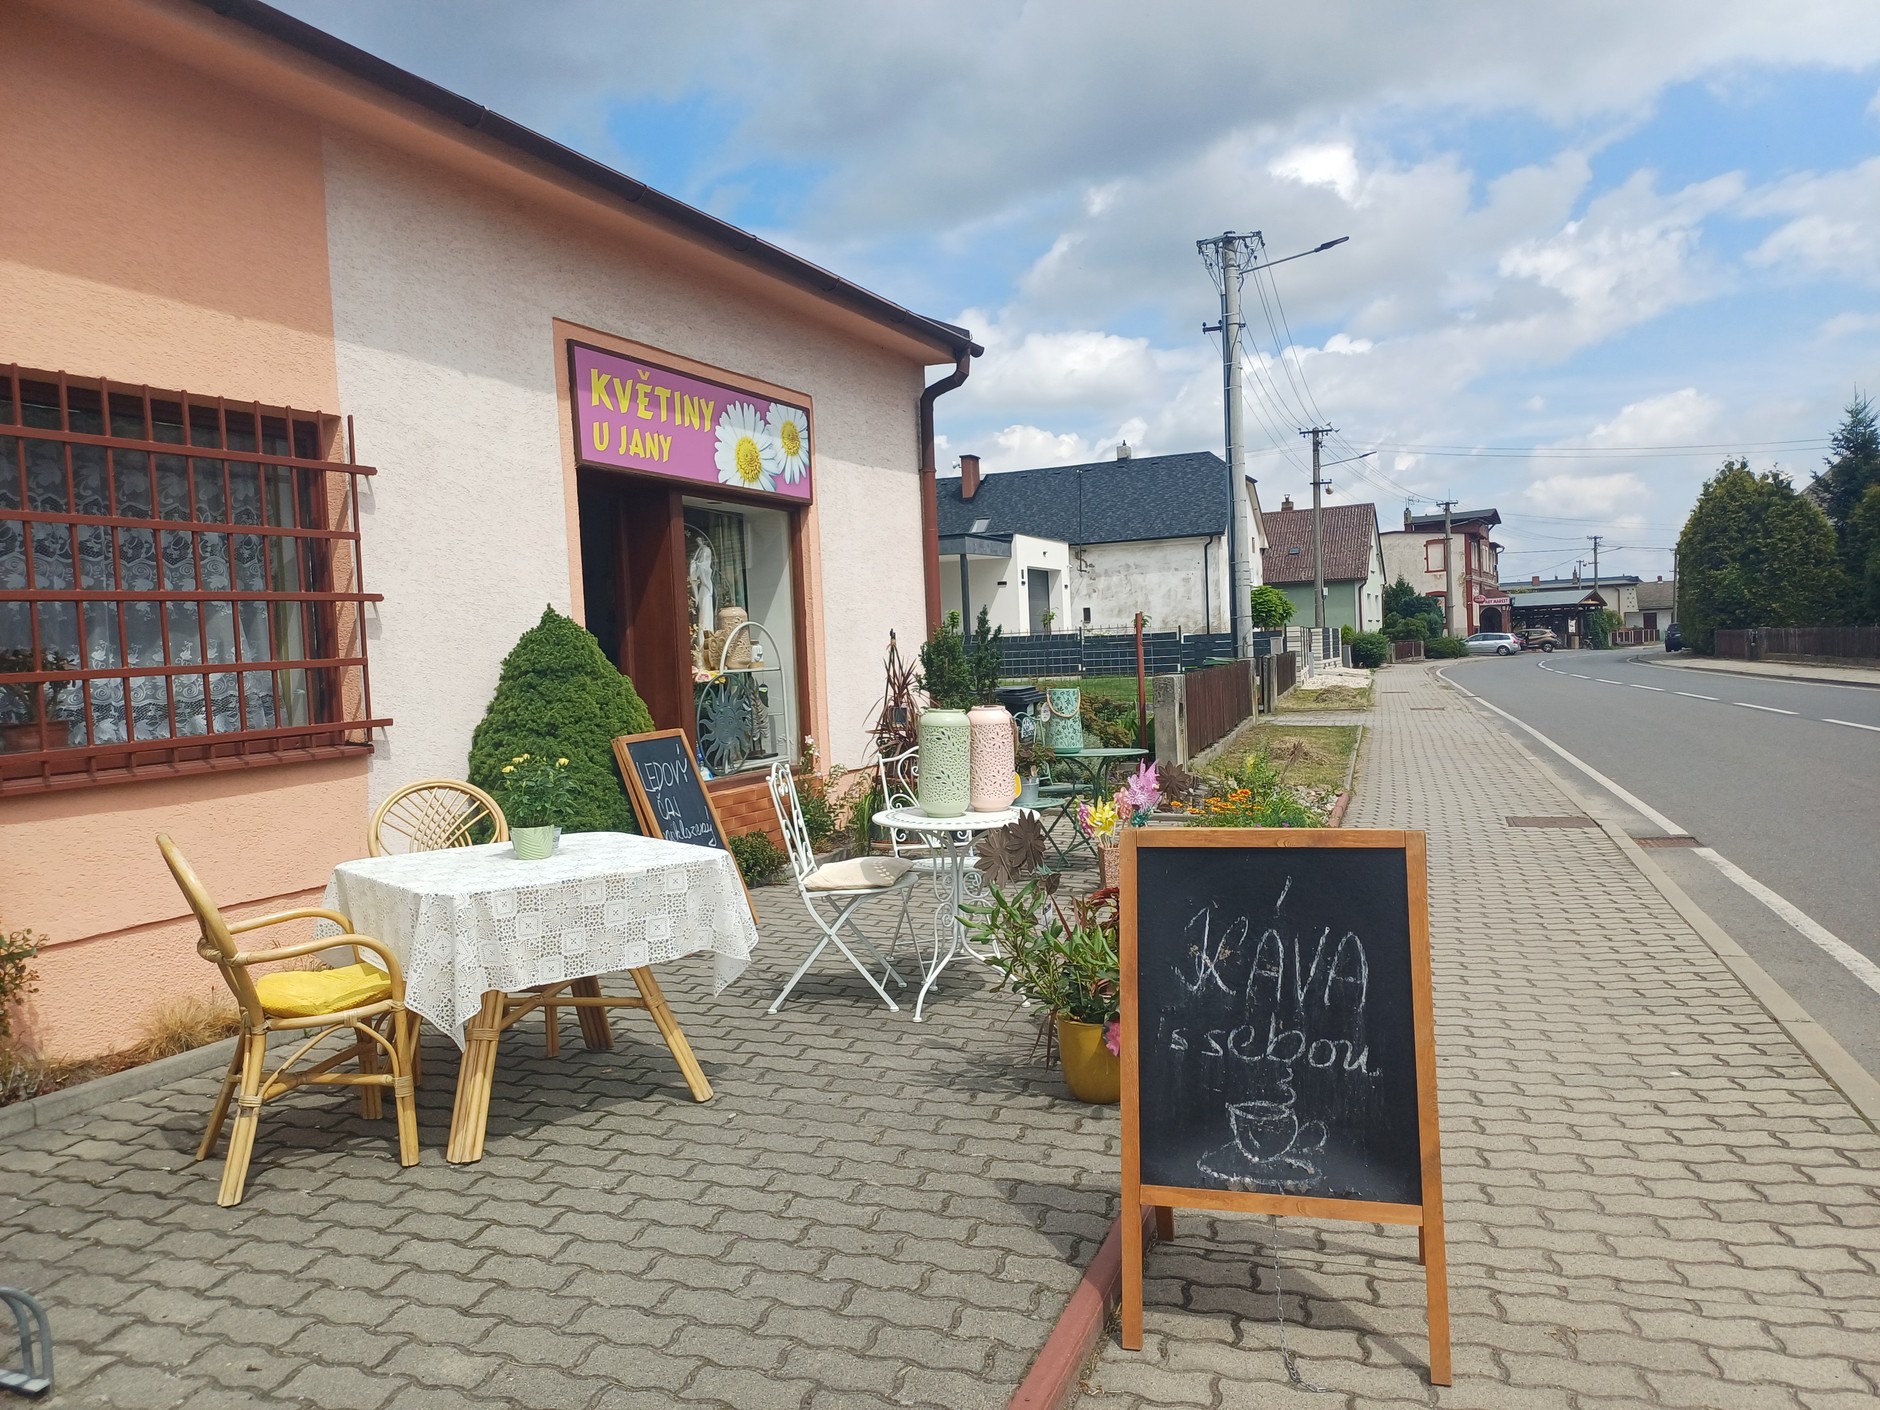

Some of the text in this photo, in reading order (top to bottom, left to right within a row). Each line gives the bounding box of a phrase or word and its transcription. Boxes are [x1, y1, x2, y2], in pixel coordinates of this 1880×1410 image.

[590, 368, 715, 433] KVĚTINY
[593, 421, 672, 463] U JANY
[636, 743, 688, 792] LEDOVÝ
[1171, 875, 1369, 1008] KÁVA
[1201, 1012, 1378, 1076] sebou
